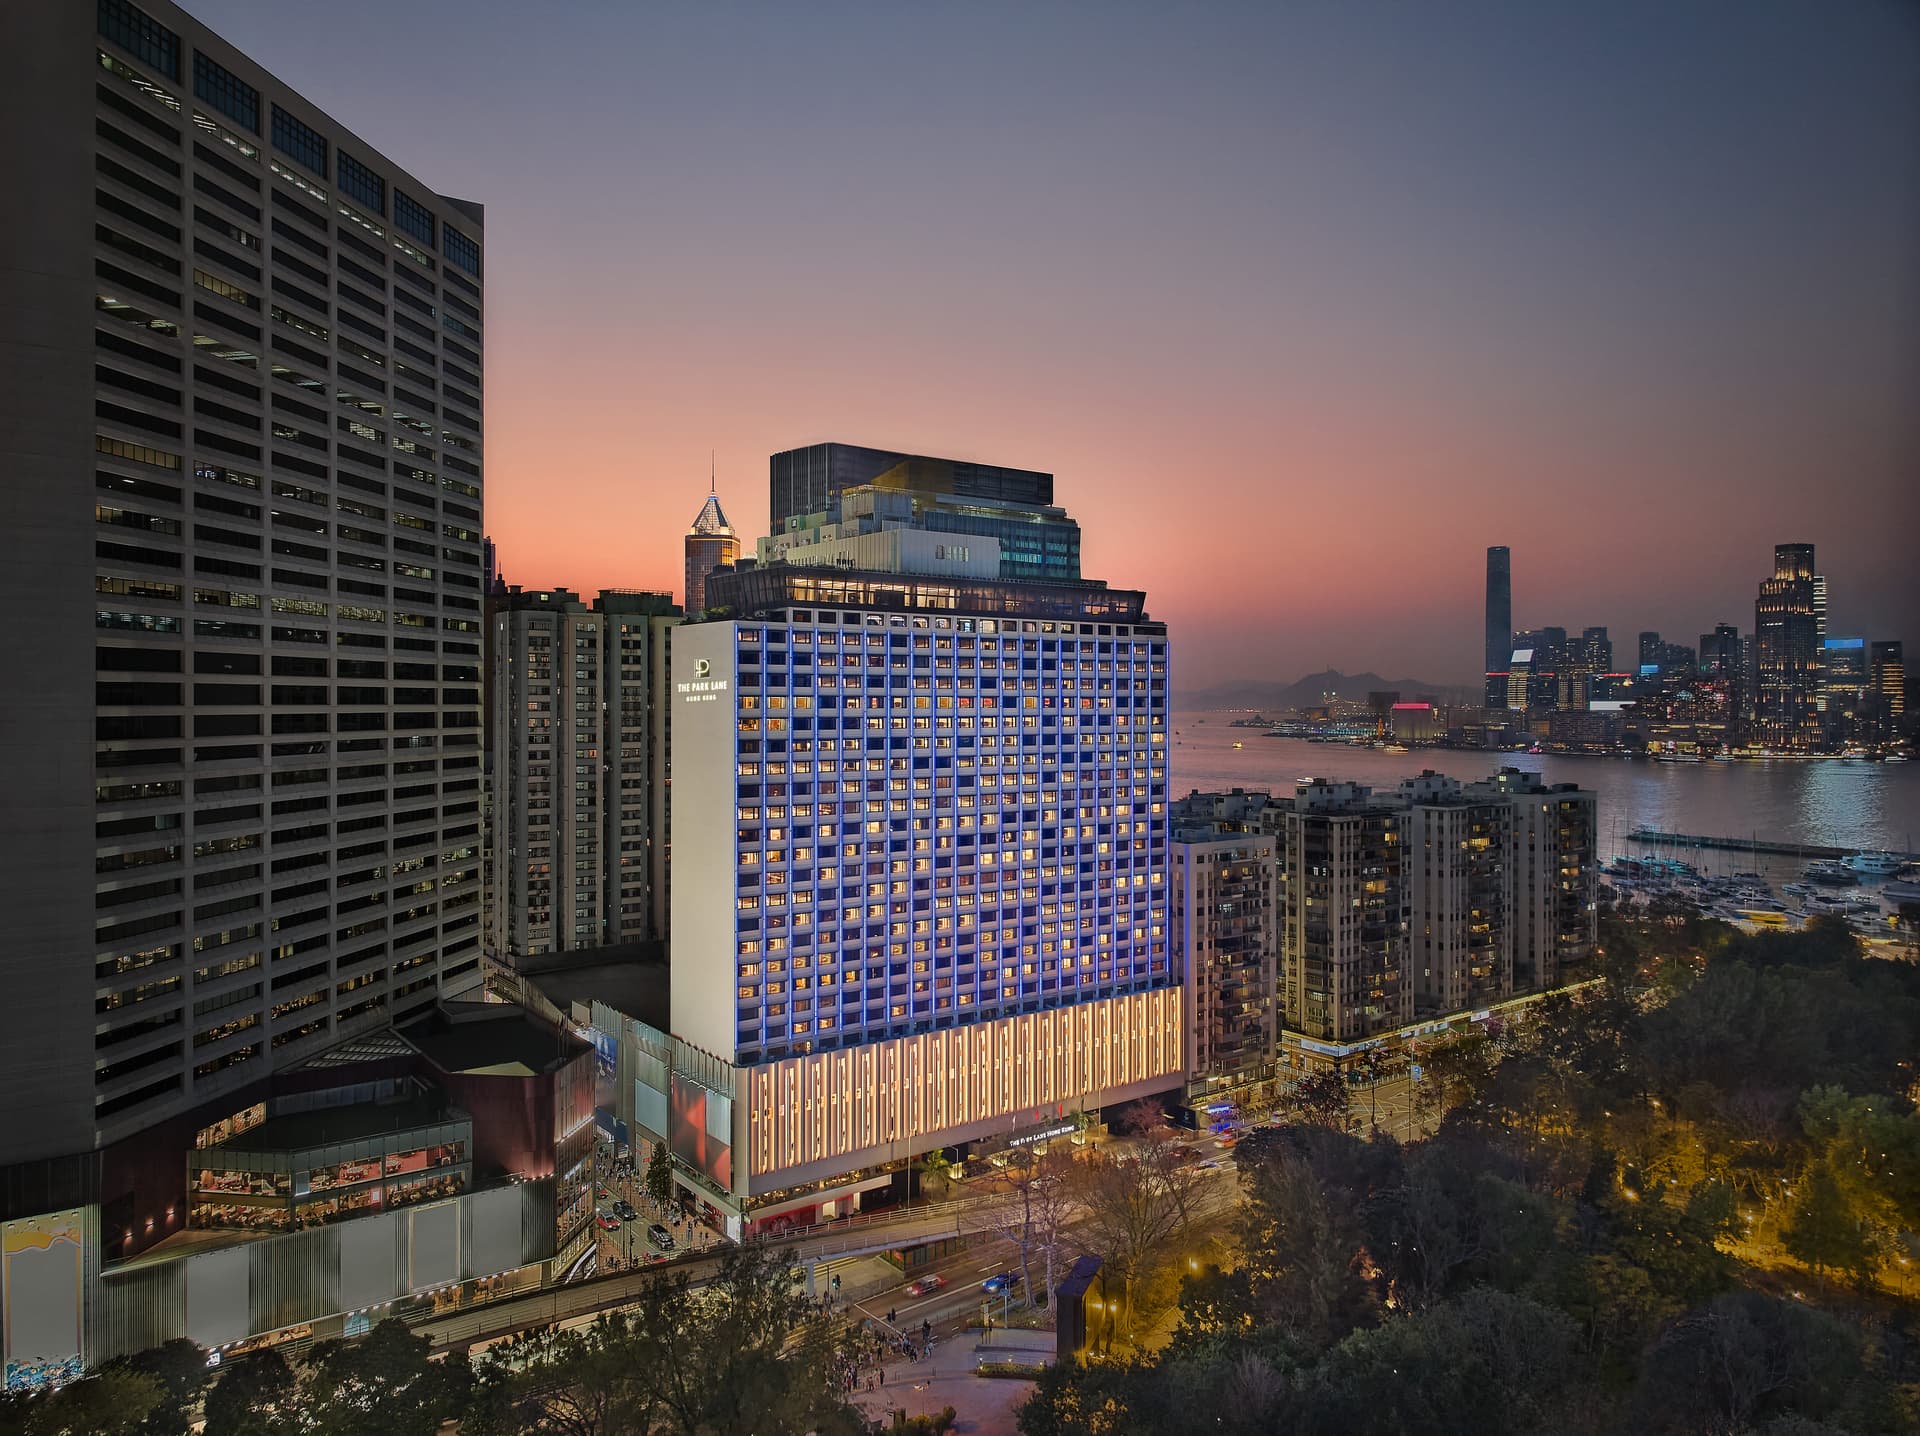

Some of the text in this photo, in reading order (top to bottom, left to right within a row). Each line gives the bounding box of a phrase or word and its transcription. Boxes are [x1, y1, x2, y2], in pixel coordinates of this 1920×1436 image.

[678, 680, 728, 692] THE PARK LANE
